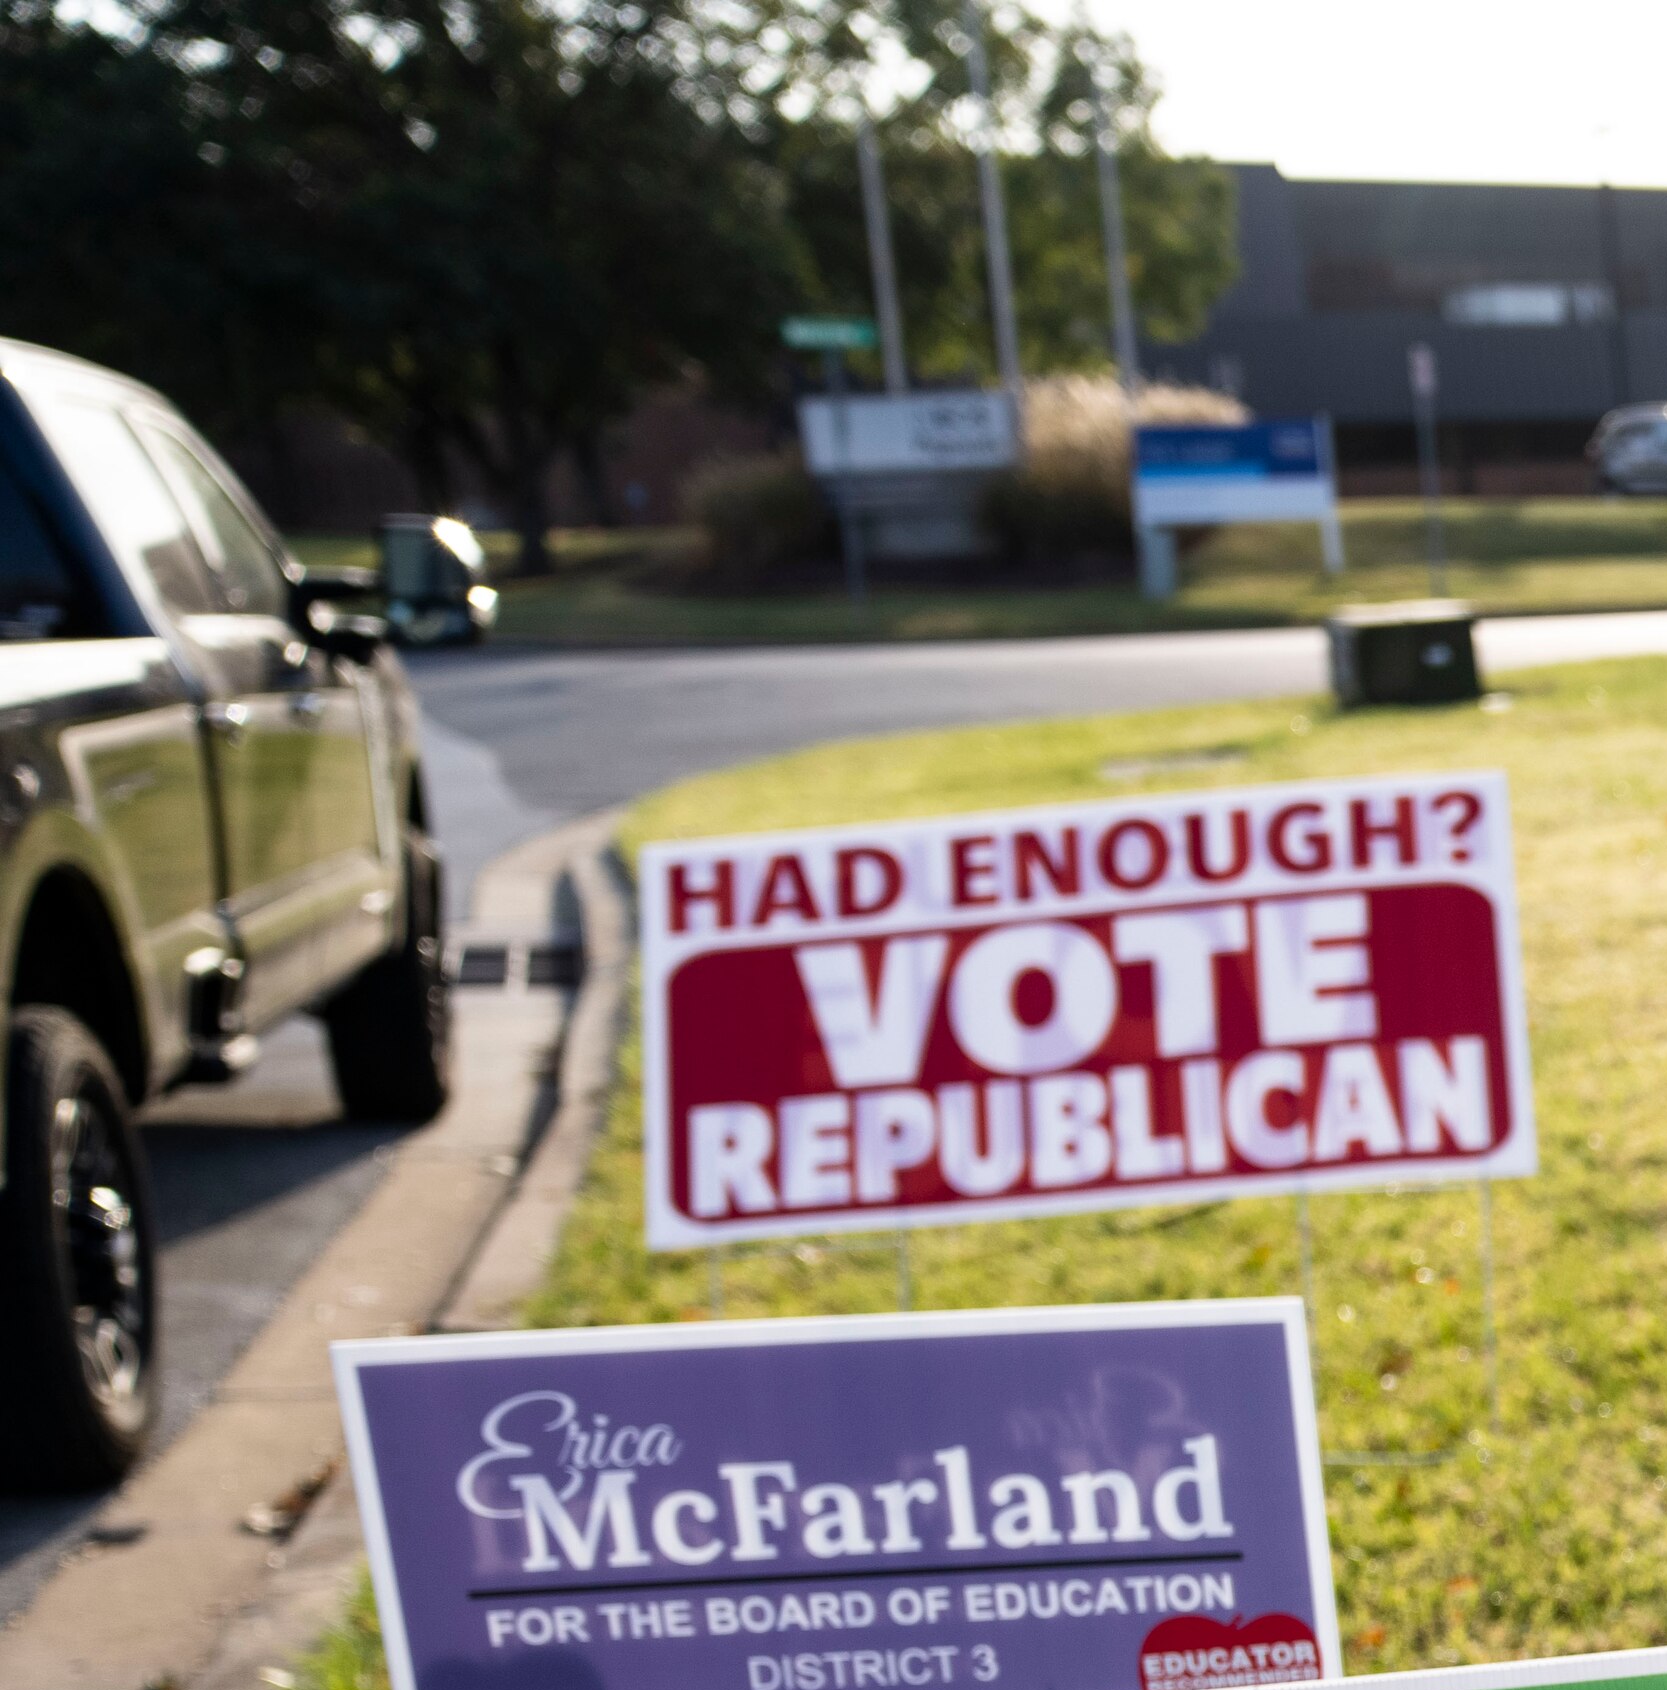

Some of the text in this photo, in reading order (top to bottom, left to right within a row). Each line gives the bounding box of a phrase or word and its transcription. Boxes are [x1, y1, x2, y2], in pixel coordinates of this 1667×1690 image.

[668, 790, 1485, 934] HAD ENOUGH?
[793, 893, 1379, 1090] VOTE
[688, 1036, 1493, 1219] REPUBLICAN
[456, 1390, 683, 1519] Erica
[508, 1434, 1234, 1573] McFarland
[485, 1573, 1236, 1647] FOR THE BOARD OF EDUCATION
[972, 1644, 1000, 1681] 3
[1142, 1639, 1316, 1677] EDUCATOR
